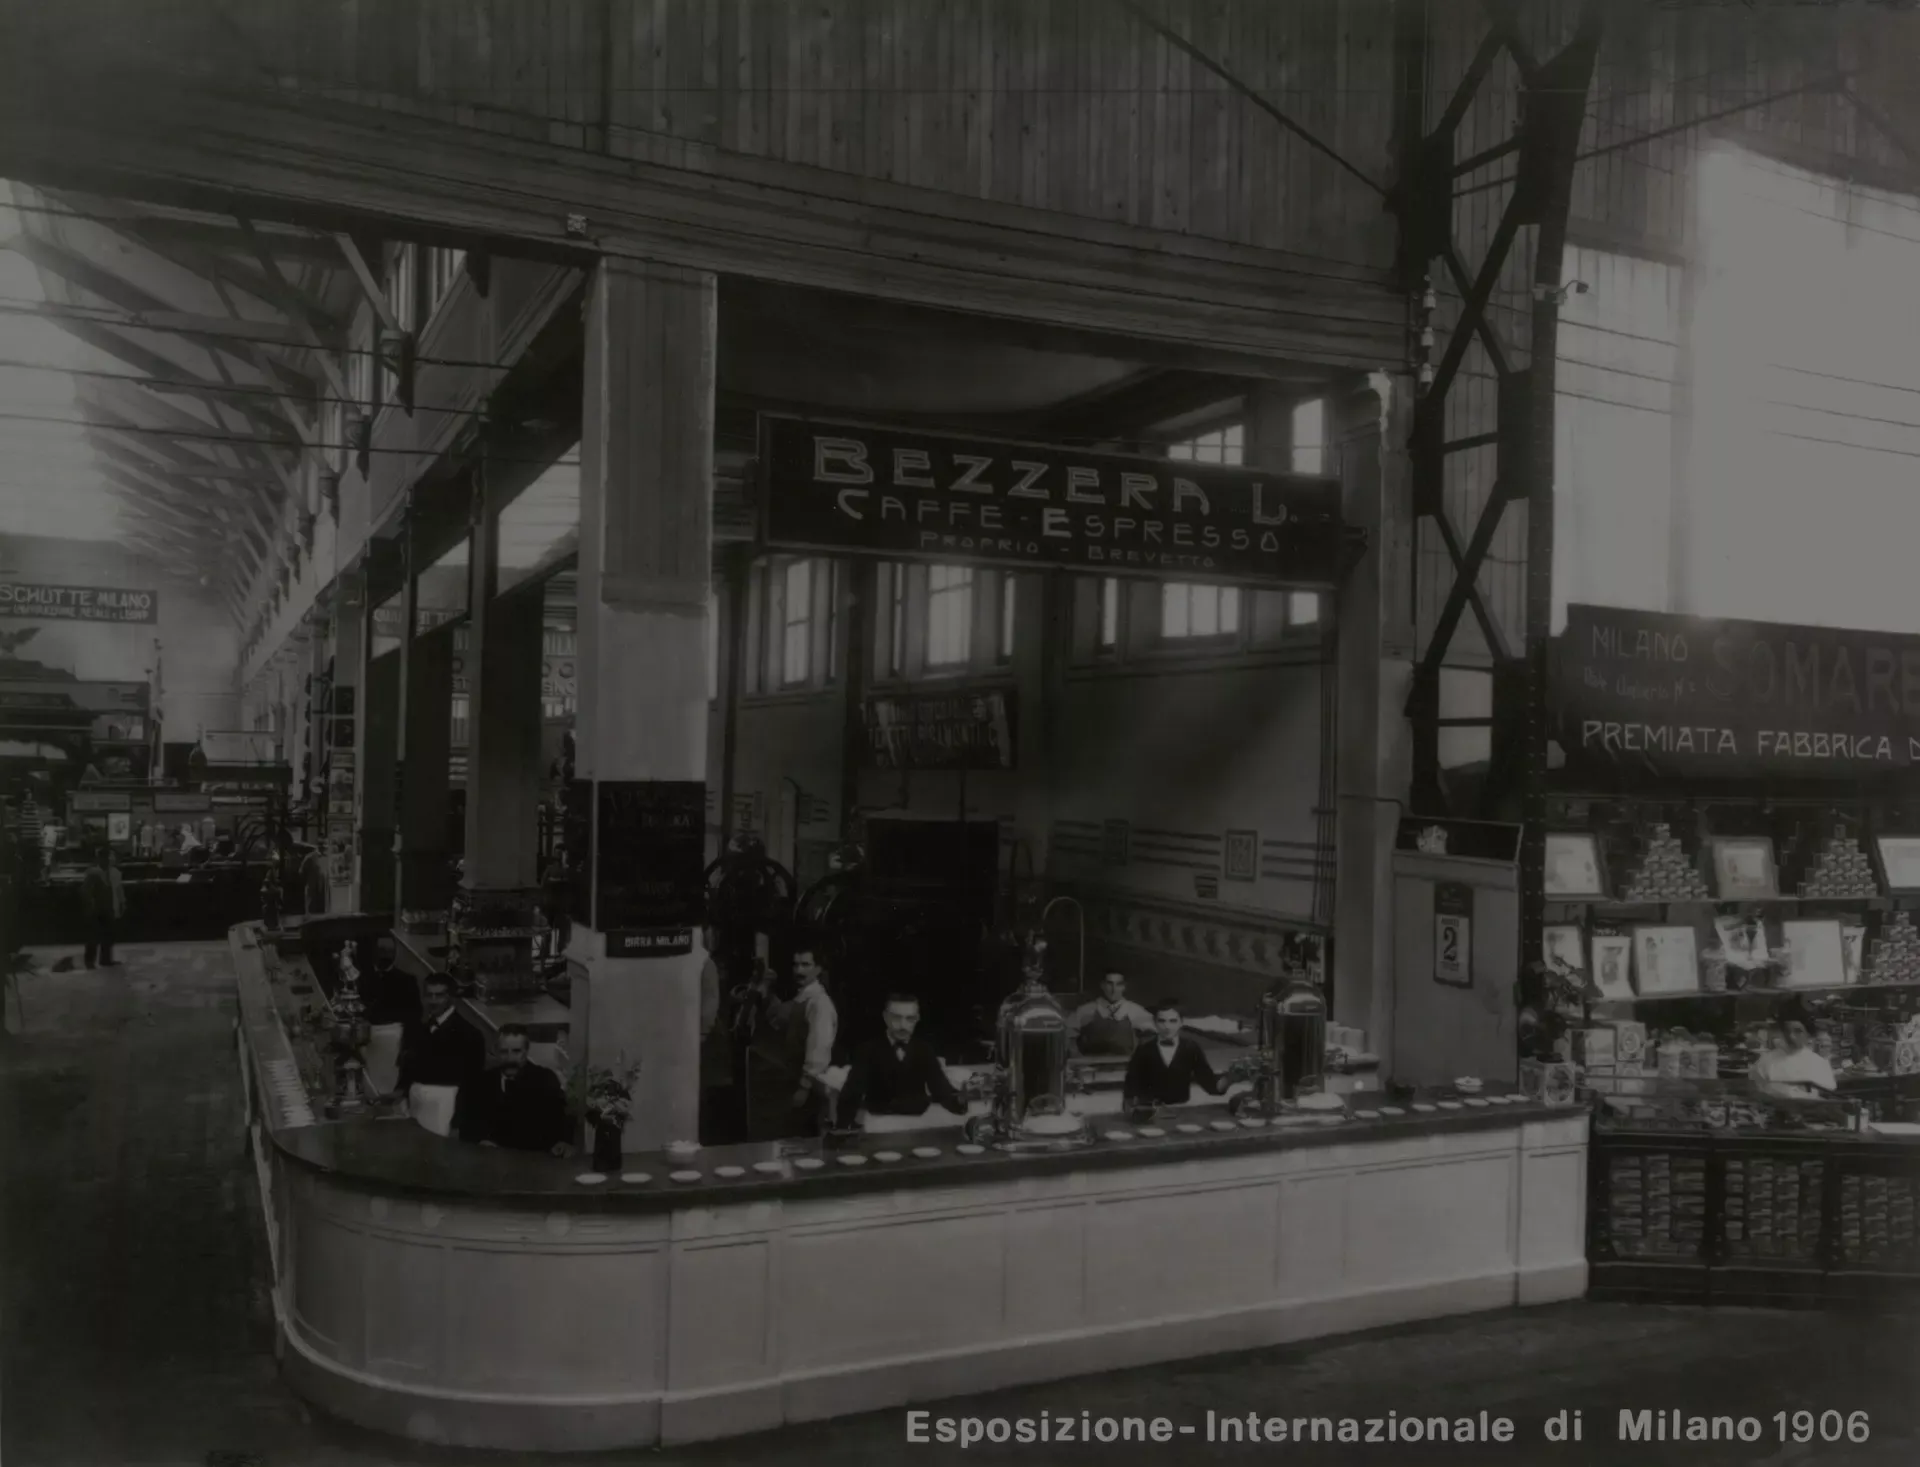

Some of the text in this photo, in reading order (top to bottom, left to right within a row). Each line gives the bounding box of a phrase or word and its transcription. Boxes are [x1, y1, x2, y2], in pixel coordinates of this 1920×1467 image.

[811, 435, 1211, 516] BEZZERA
[1042, 507, 1279, 552] ESPRESSO
[920, 530, 1040, 554] PROPRIO
[1088, 544, 1217, 568] BREVETTO
[97, 591, 151, 610] MILANO
[1592, 624, 1689, 662] MILANO
[1582, 719, 1738, 756] PREMIATA
[1757, 730, 1893, 761] FABBRICA
[1443, 926, 1458, 962] 2
